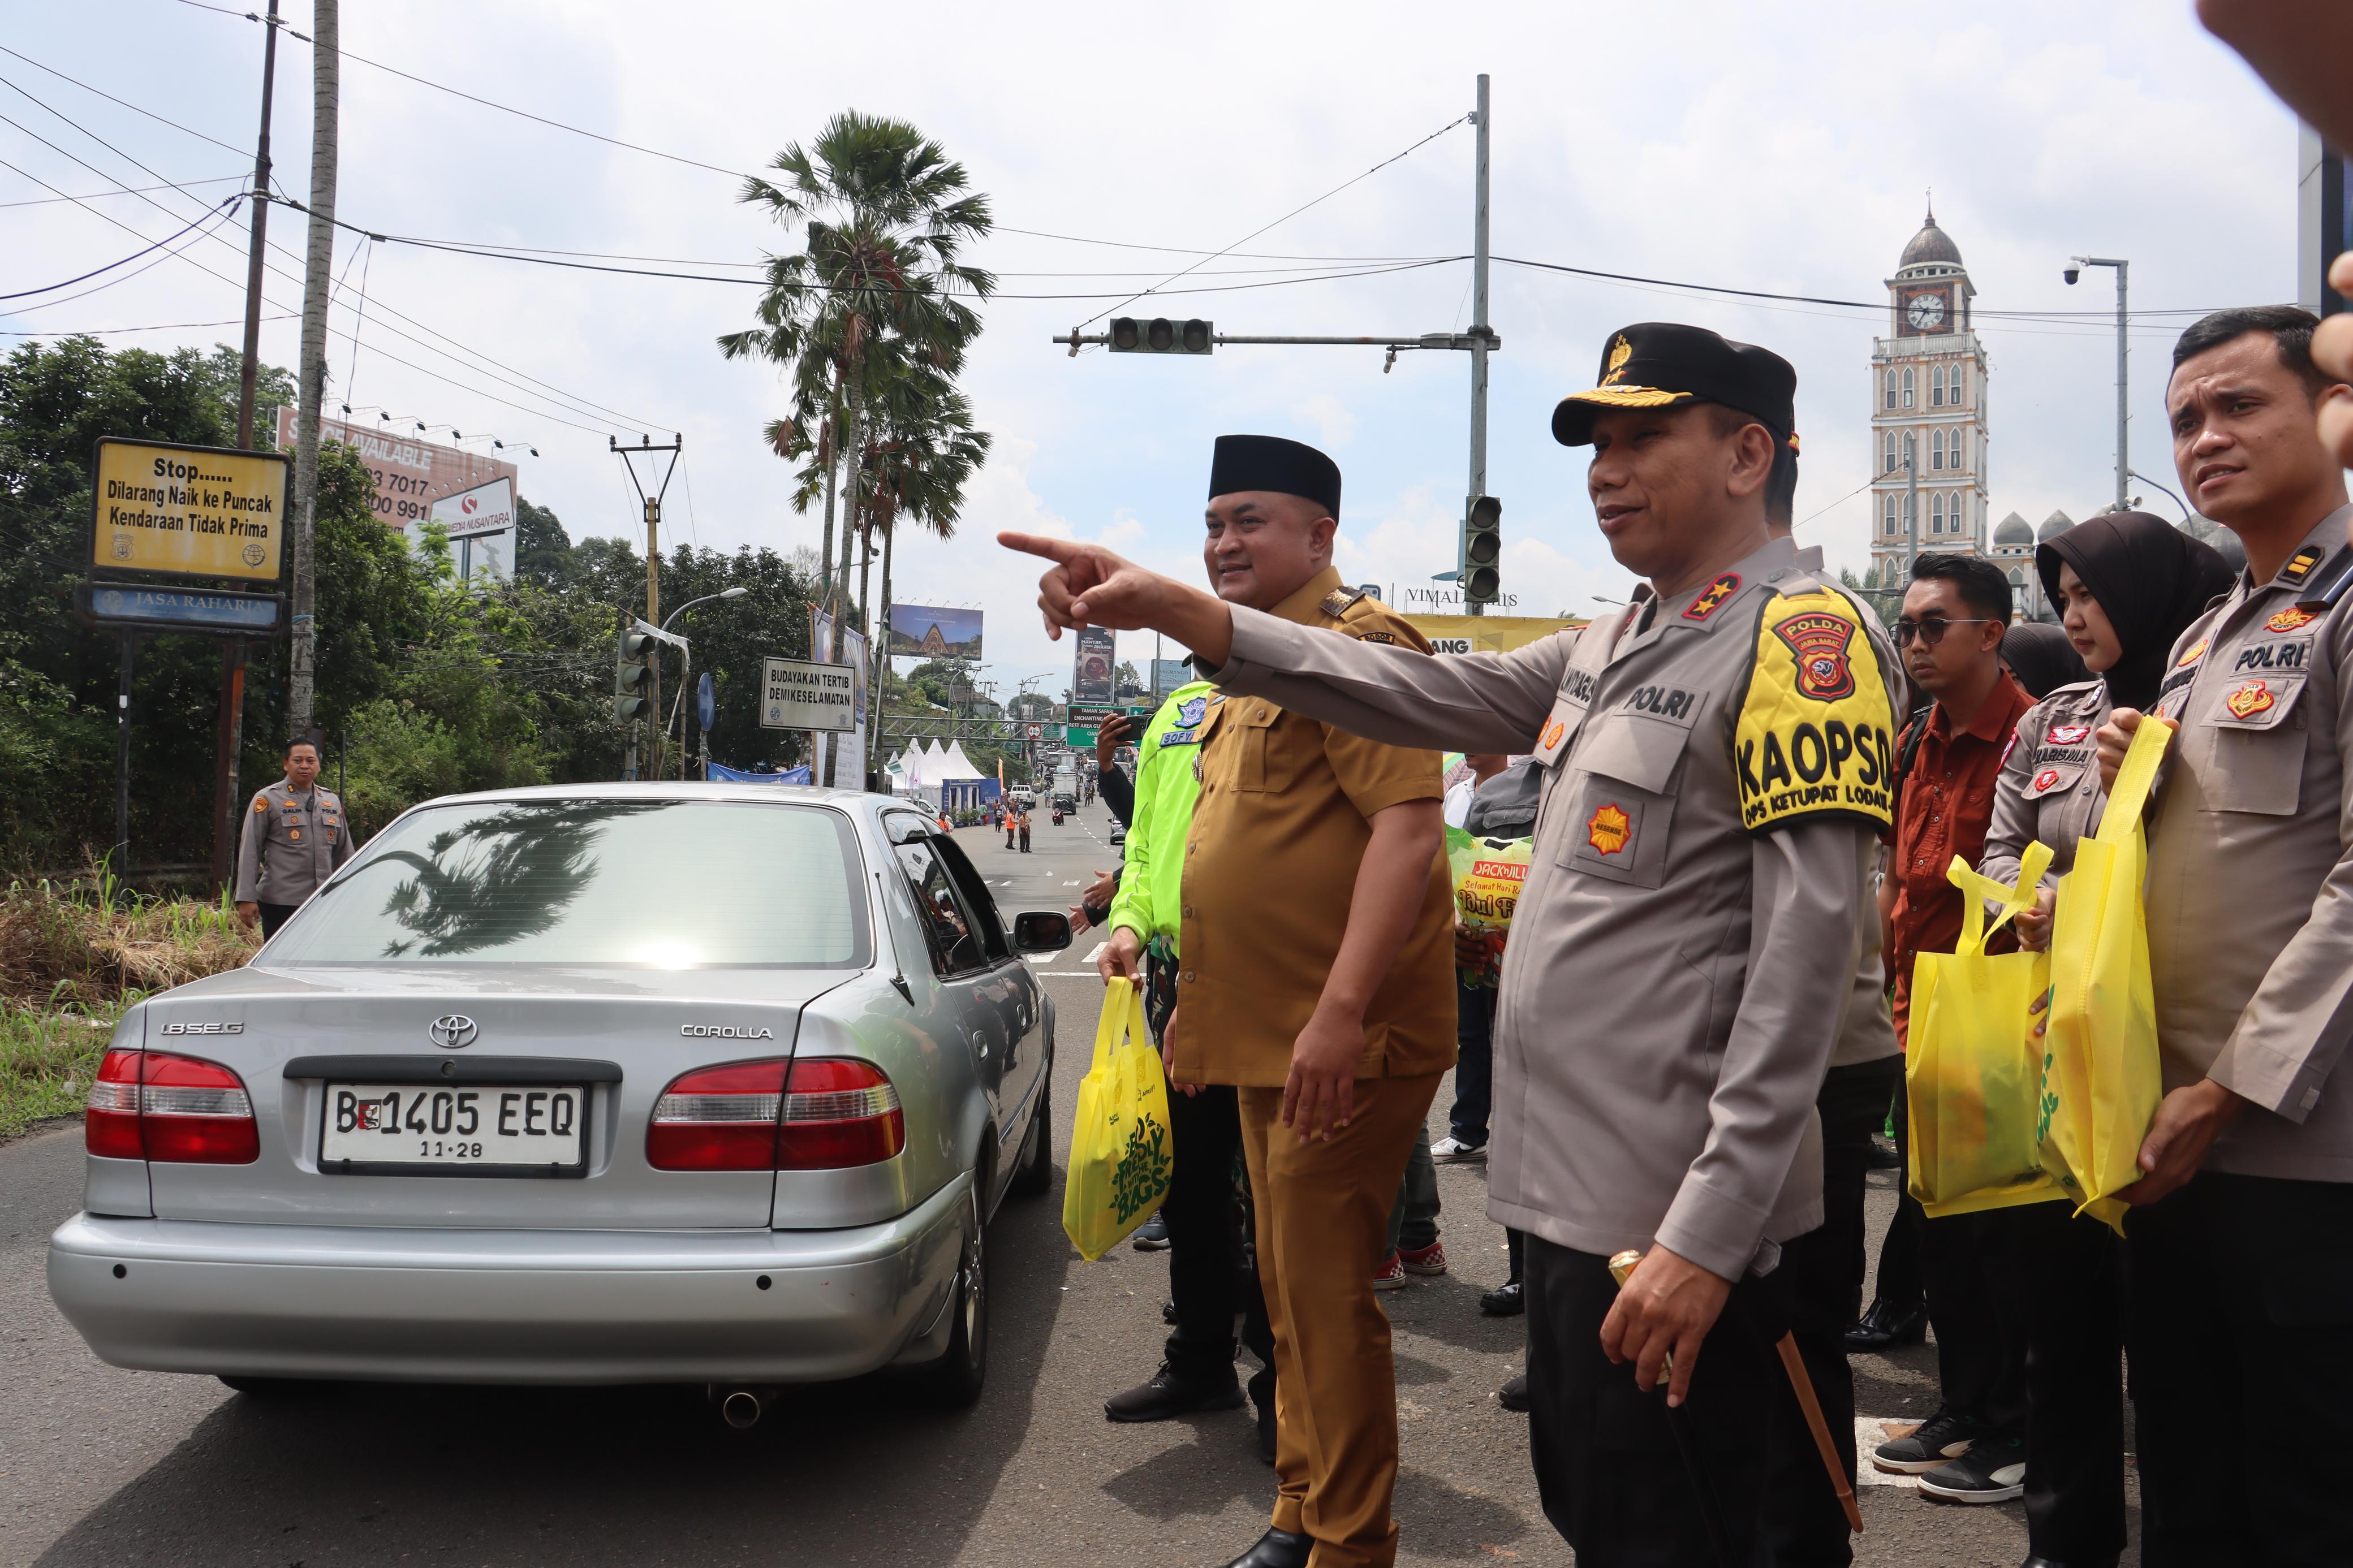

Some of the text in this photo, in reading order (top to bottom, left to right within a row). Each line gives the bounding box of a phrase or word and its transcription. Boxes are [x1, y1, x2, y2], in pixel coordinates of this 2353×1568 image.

[350, 434, 433, 471] AVAILABLE
[108, 480, 272, 512] Dilarang Naik ke Puncak
[389, 473, 429, 496] 7017
[397, 500, 427, 521] 991
[466, 512, 510, 530] NUSANTARA
[110, 507, 268, 538] Kendaraan Tidak Prima
[135, 593, 265, 611] JASA RAHARJA
[1786, 619, 1843, 637] POLDA
[1800, 638, 1839, 647] JAWA BARAT
[2235, 642, 2305, 672] POLRI
[772, 669, 849, 689] BUDAYAKAN TERTIB
[1624, 685, 1695, 720] POLRI
[1746, 800, 1767, 826] OPS
[1770, 785, 1838, 813] KETUPAT
[1596, 823, 1622, 836] RESERSE
[1465, 880, 1495, 891] Selamat
[1497, 883, 1511, 893] Hari
[1458, 889, 1494, 917] Idul
[680, 1025, 773, 1039] COROLLA
[337, 1091, 573, 1136] B 1405 EEQ
[1117, 1167, 1166, 1225] BAGS
